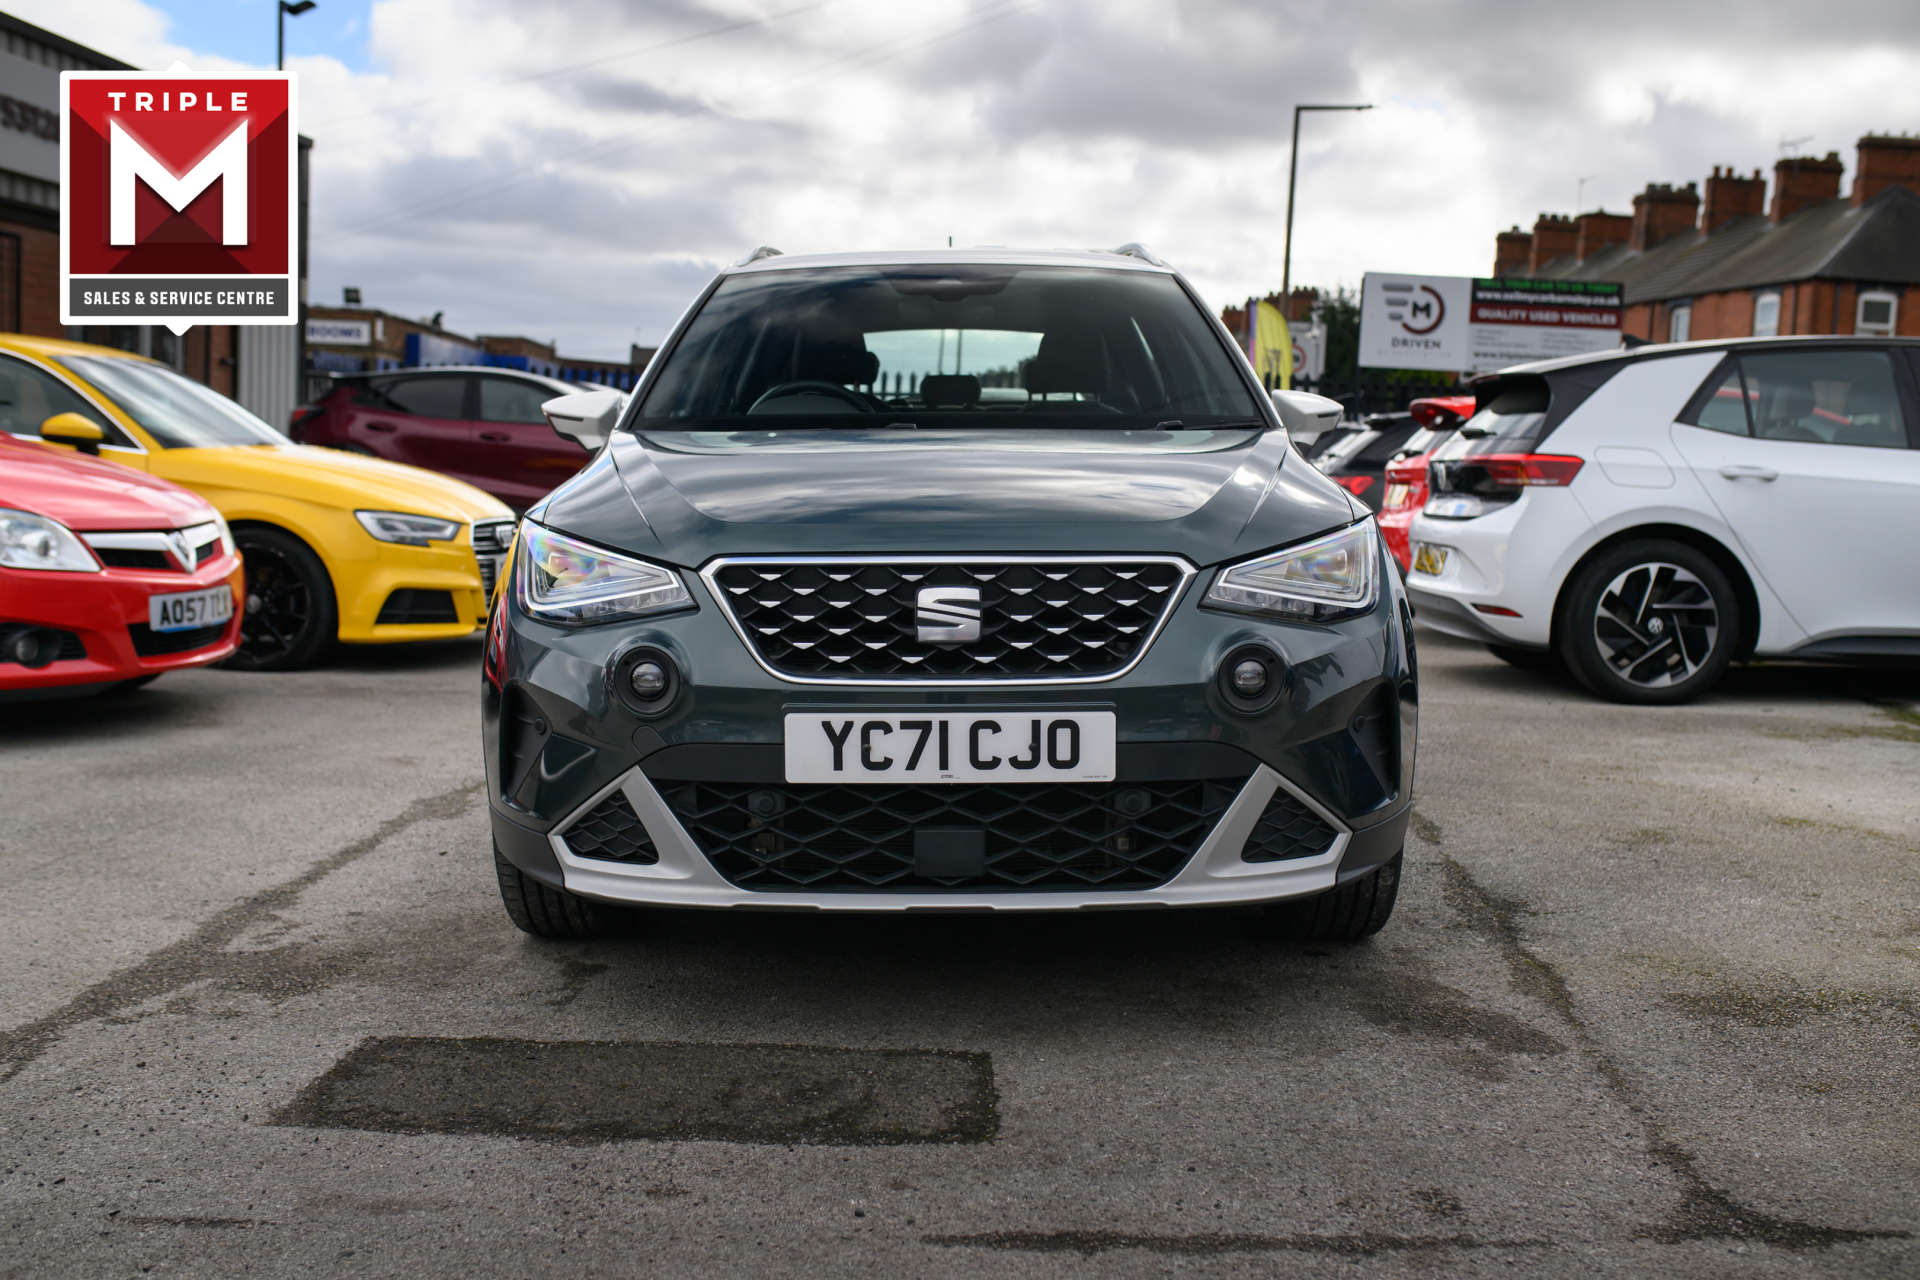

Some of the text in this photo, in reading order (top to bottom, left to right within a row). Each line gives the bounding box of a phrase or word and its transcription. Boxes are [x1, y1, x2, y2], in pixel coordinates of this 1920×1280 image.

[1411, 301, 1432, 319] M
[1477, 307, 1618, 326] QUALITY USED VEHICLES
[1391, 337, 1441, 350] DRIVEN
[160, 596, 206, 626] AO57
[821, 719, 1080, 771] YC71 CJO
